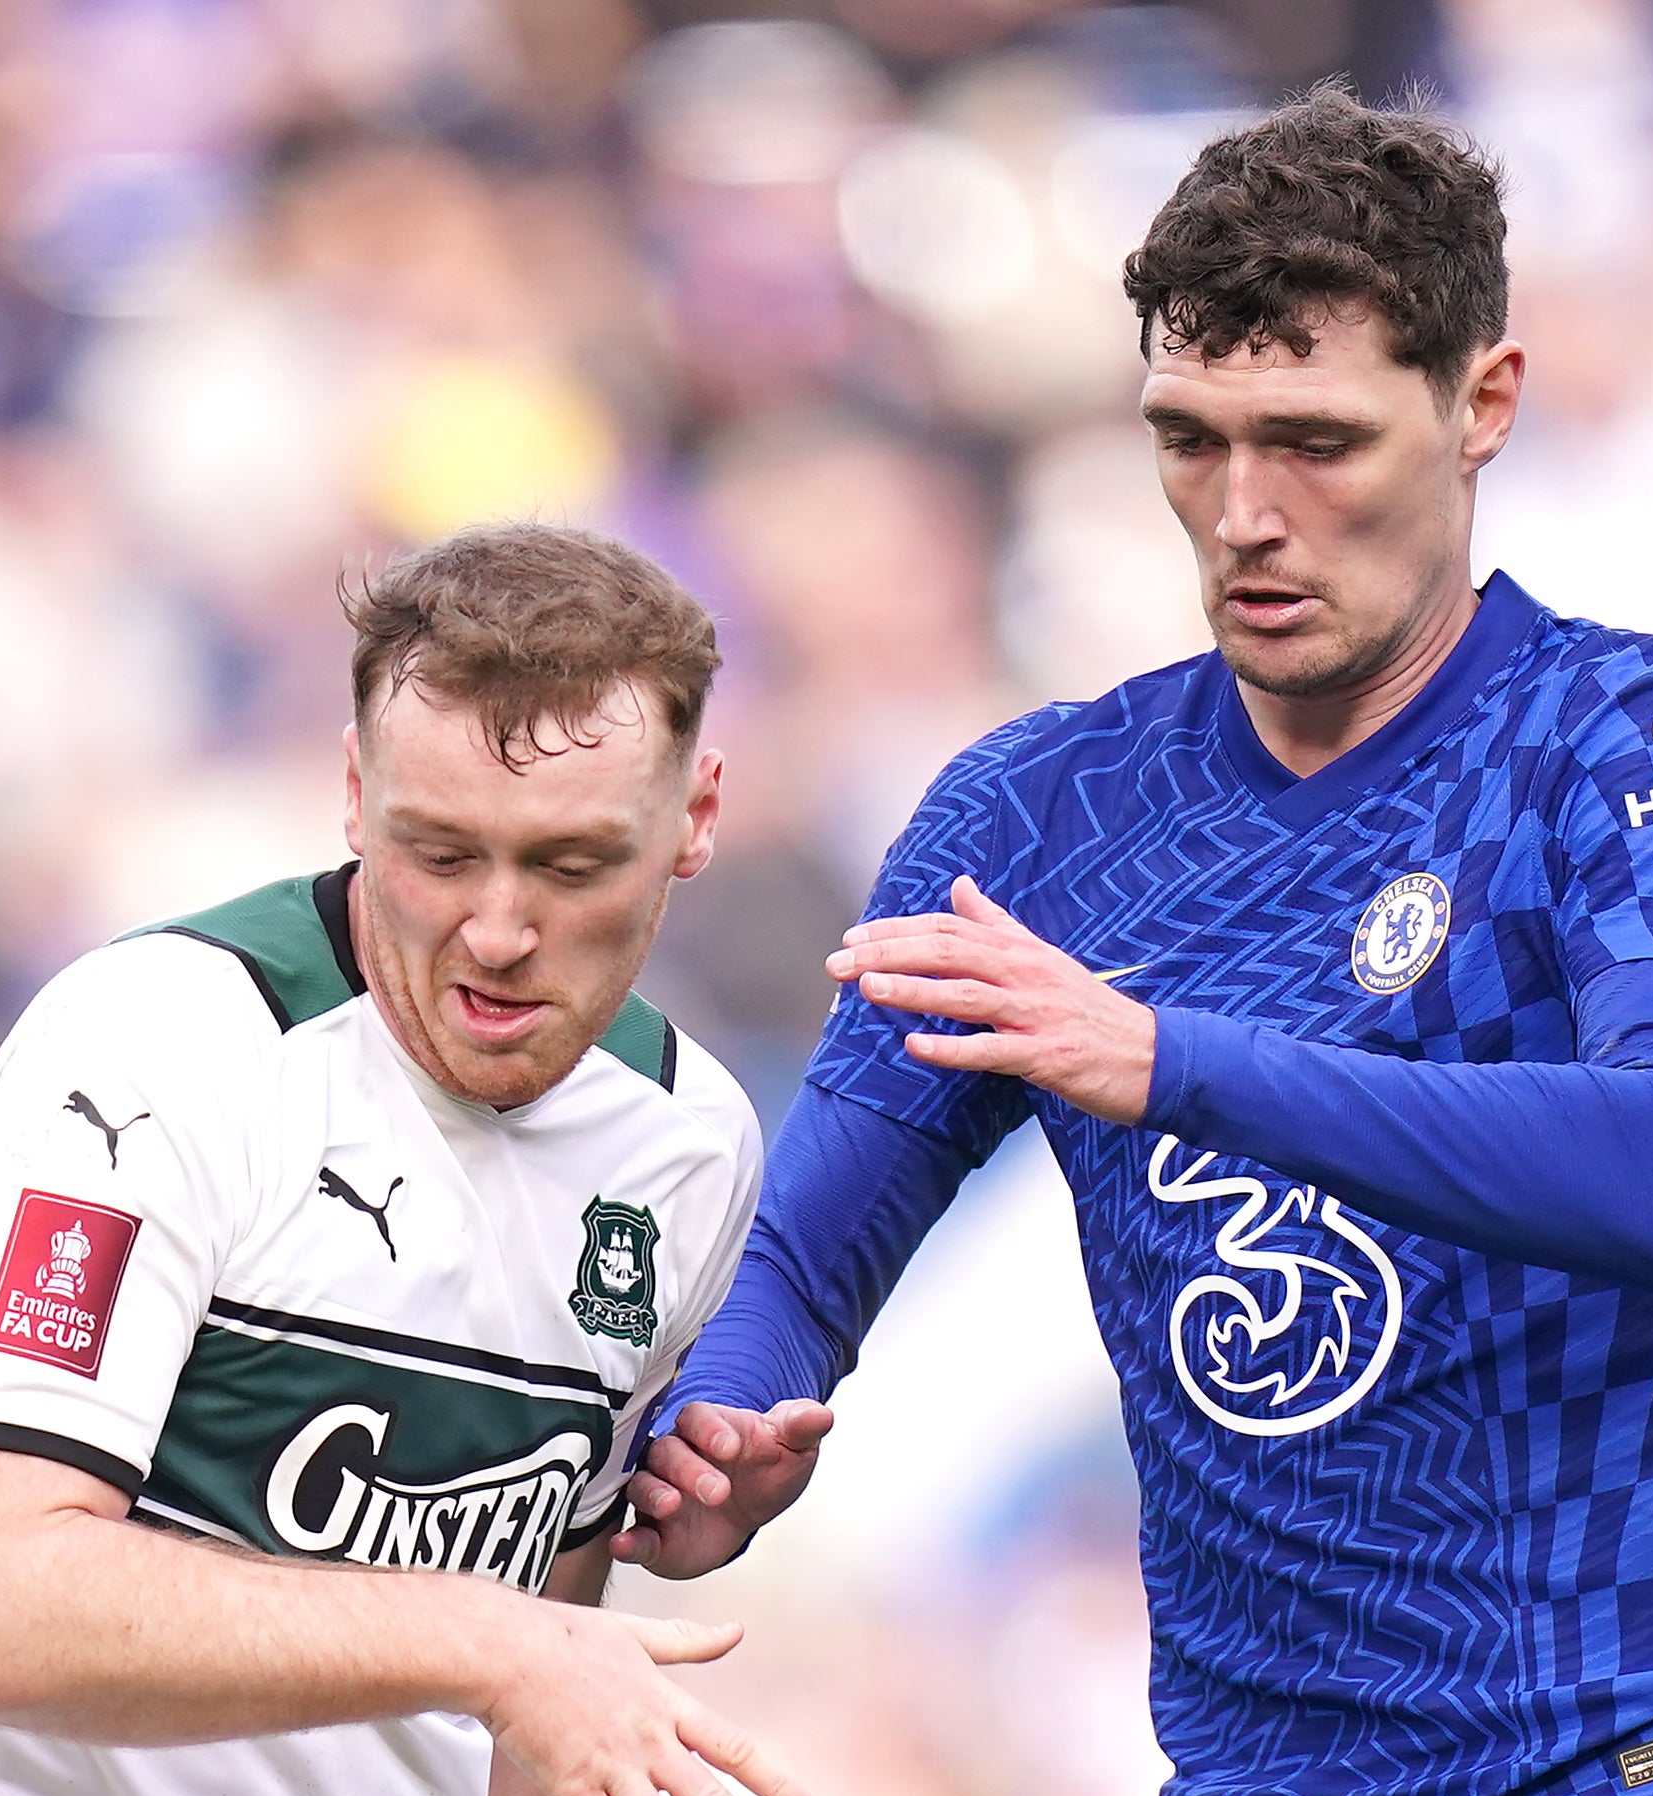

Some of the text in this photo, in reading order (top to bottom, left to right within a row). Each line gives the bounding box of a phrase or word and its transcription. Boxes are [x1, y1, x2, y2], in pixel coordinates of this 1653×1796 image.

[1373, 877, 1437, 914] CHELSEA
[1365, 953, 1430, 988] FOOTBALL CLUB
[7, 1289, 97, 1331] Emirates
[0, 1310, 93, 1353] FA CUP
